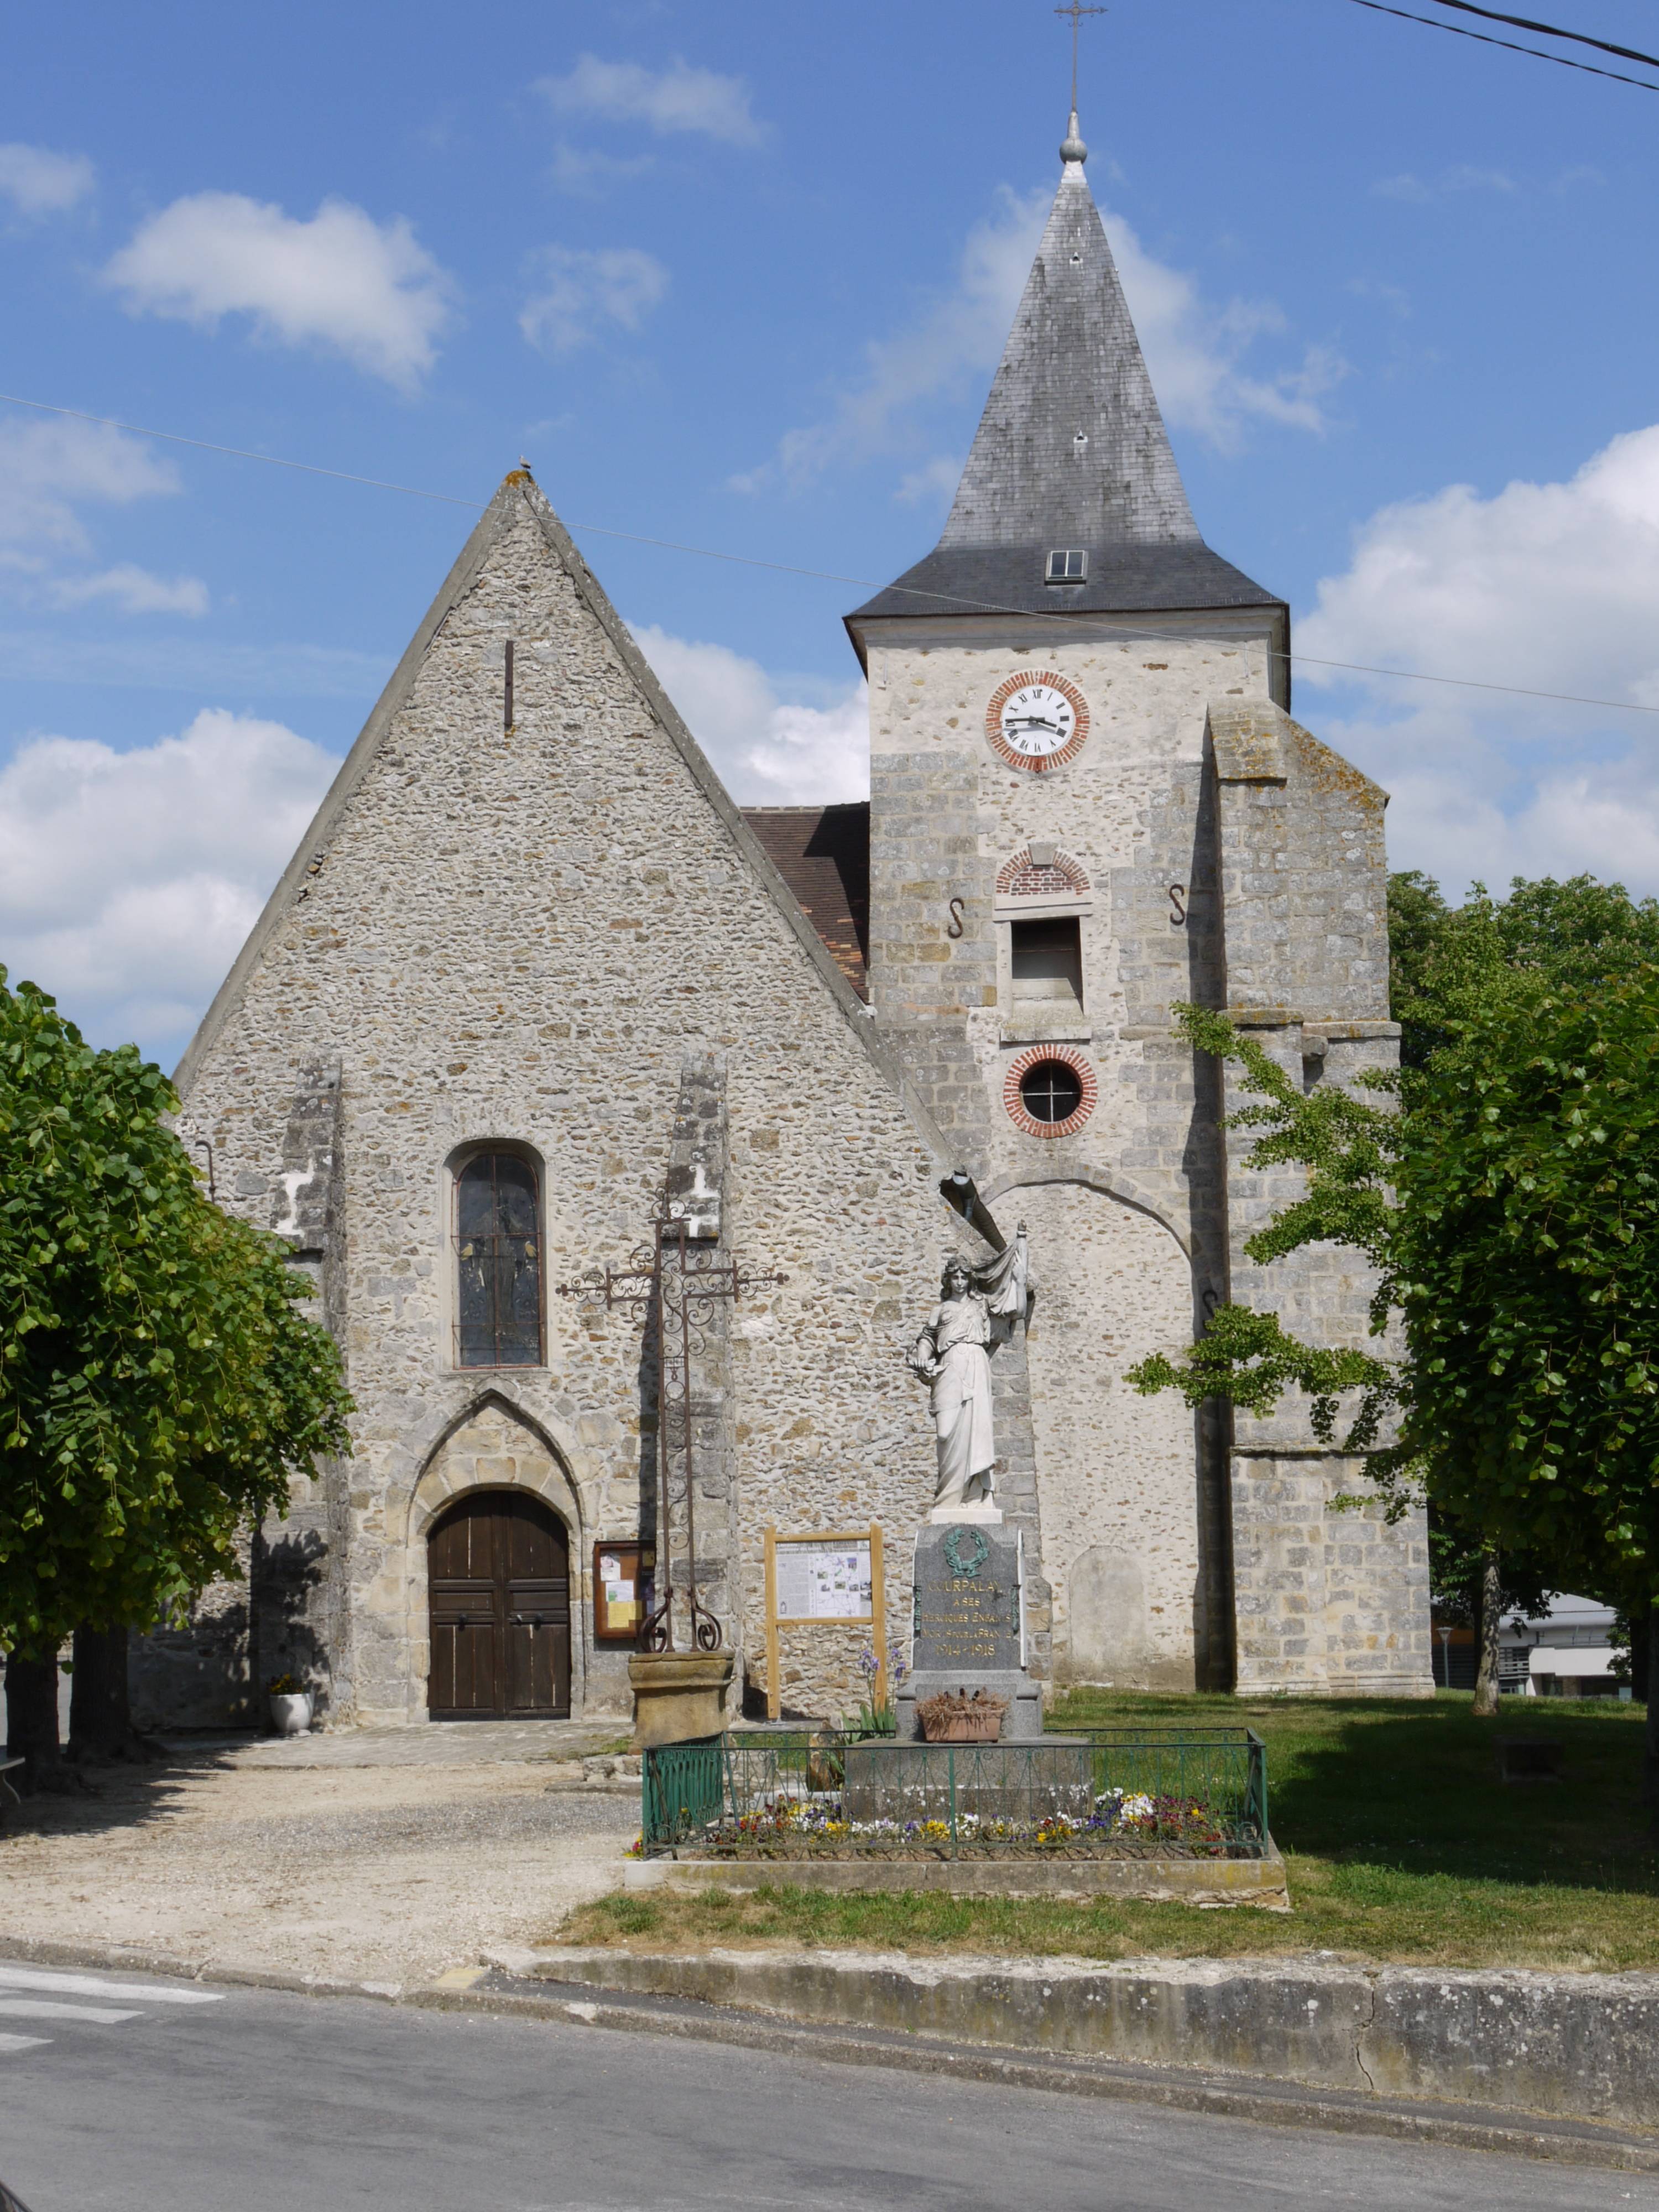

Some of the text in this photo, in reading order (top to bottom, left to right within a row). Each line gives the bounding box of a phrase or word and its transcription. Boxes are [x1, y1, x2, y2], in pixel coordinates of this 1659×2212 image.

[1018, 693, 1028, 705] XI
[1032, 689, 1042, 699] XII
[1047, 692, 1053, 701] I
[1009, 705, 1019, 713] X
[1019, 739, 1029, 751] VII
[1034, 743, 1041, 753] VI
[962, 1597, 980, 1606] SES
[972, 1611, 1011, 1623] ENFANS
[978, 1628, 1011, 1639] FRANE
